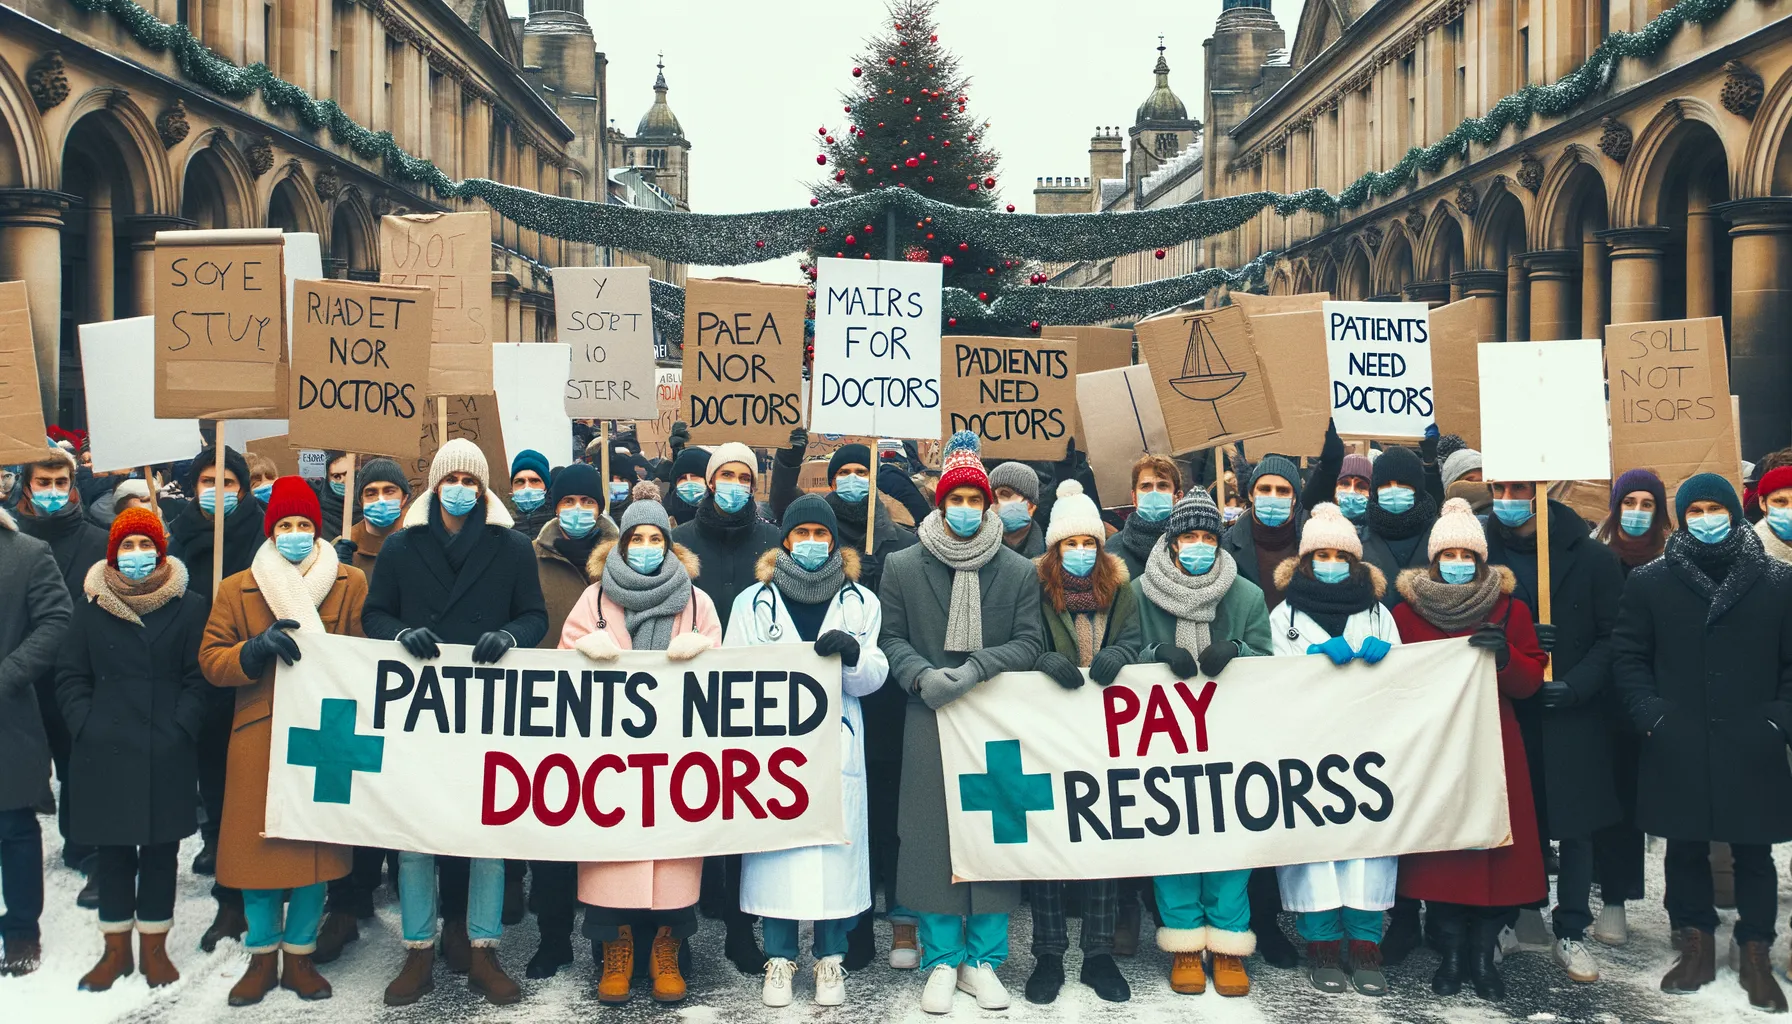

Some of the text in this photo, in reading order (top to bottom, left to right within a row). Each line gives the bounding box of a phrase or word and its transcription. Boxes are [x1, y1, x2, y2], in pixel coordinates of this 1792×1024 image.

[592, 278, 608, 299] Y
[827, 286, 924, 318] MAIRS
[307, 291, 416, 330] RIADET
[1330, 312, 1428, 343] PATIENTS
[697, 311, 782, 346] PAEA
[846, 326, 911, 360] FOR
[329, 337, 390, 369] NOR
[698, 351, 776, 384] NOR
[955, 343, 1068, 379] PADIENTS
[1348, 351, 1406, 378] NEED
[821, 373, 940, 408] DOCTORS
[979, 379, 1039, 403] NED
[1620, 366, 1694, 391] NOT
[298, 375, 416, 419] DOCTORS
[690, 393, 801, 428] DOCTORS
[1333, 380, 1434, 417] DOCTORS
[950, 408, 1066, 441] DOCTORS
[373, 659, 828, 738] PATTIENTS NEED
[1103, 681, 1218, 758] PAY
[481, 747, 809, 827] DOCTORS
[1063, 750, 1395, 843] RESTTORSS
